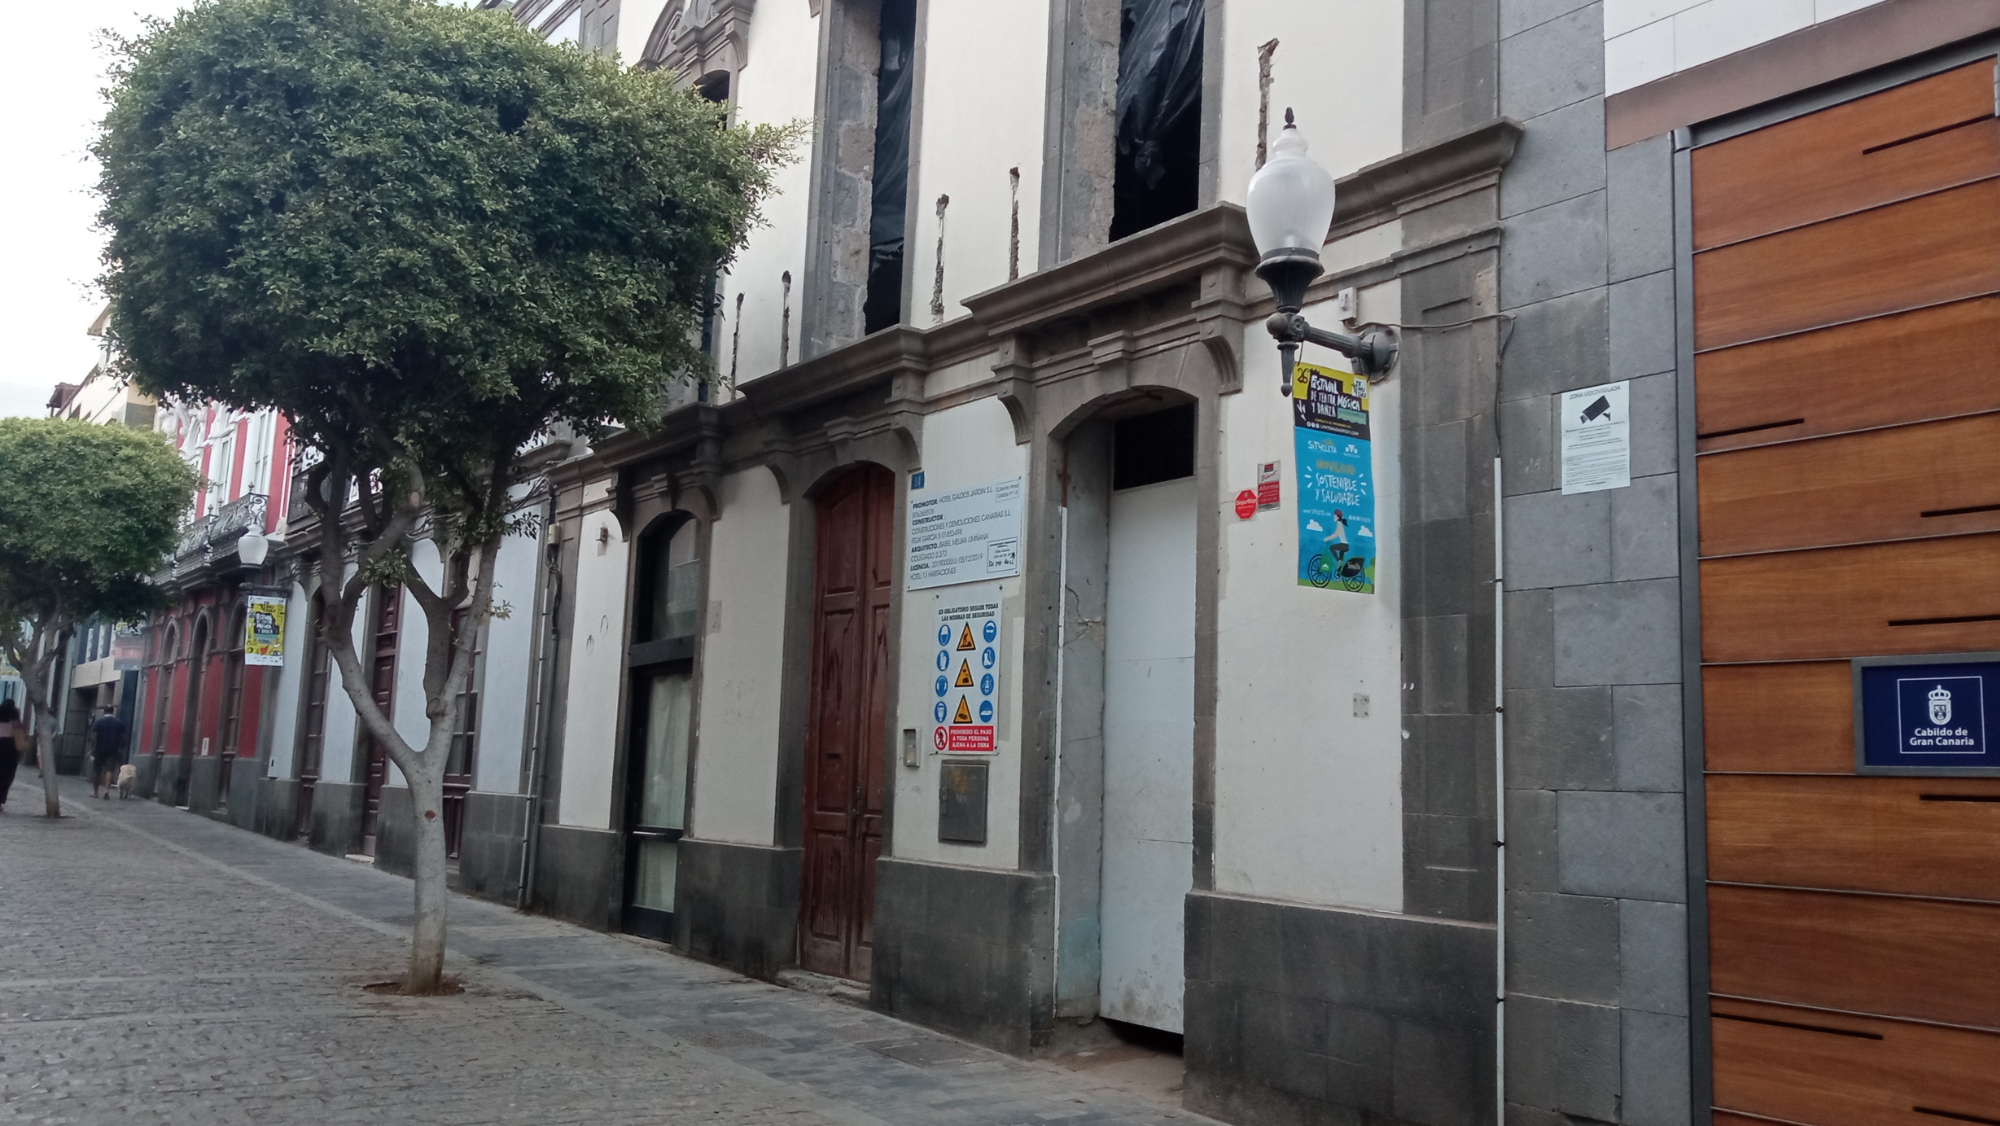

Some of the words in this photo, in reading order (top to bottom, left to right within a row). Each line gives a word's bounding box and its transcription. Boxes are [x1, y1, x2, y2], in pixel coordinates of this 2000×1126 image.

[1311, 375, 1339, 394] FESTIVAL
[1317, 402, 1336, 417] DANZA
[1315, 472, 1357, 492] SOSTENIBLE
[1321, 488, 1360, 506] SALUDABLE
[944, 606, 969, 614] OBLIGATORIO
[972, 611, 995, 619] SEGURIDAD
[1914, 727, 1953, 737] Cabildo
[1954, 727, 1968, 736] de
[1909, 737, 1933, 746] Gran
[1935, 737, 1975, 746] Canaria
